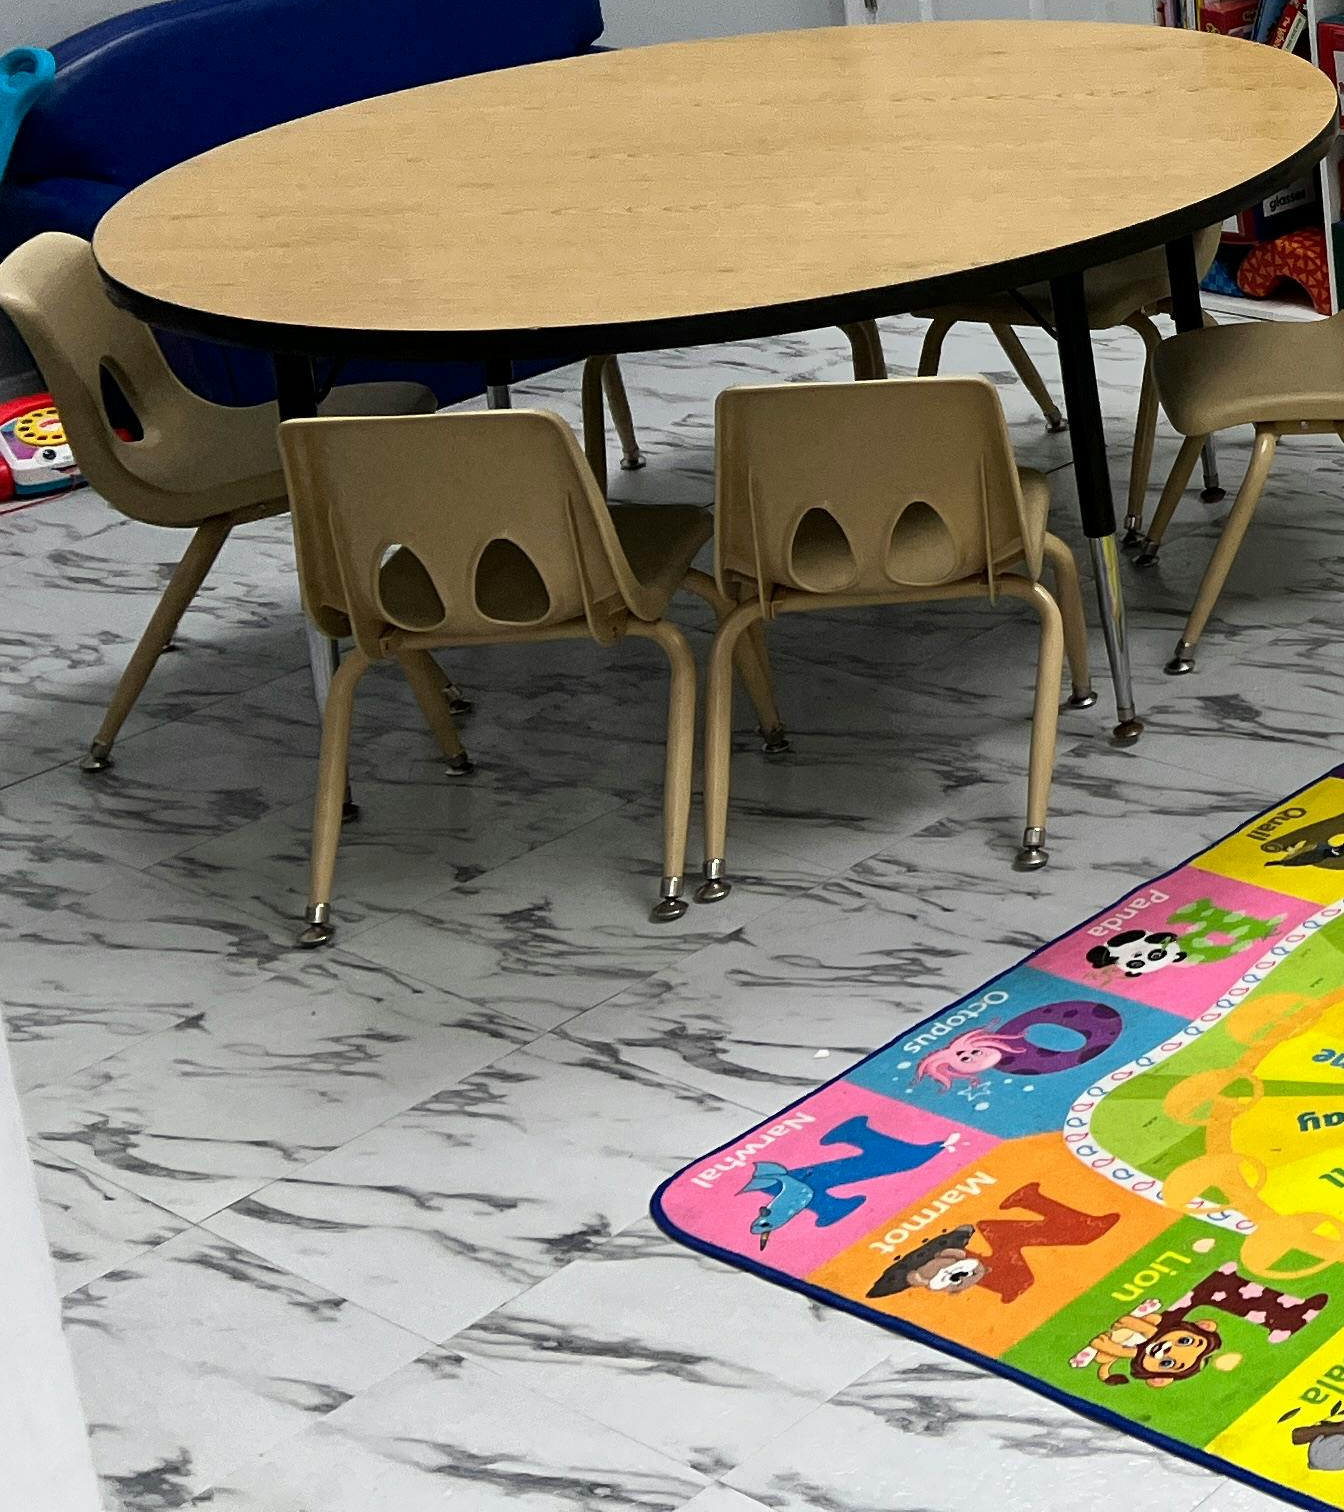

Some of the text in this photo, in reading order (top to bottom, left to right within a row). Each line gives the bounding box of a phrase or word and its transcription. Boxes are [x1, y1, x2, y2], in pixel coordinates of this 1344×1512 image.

[1247, 806, 1308, 842] Quail
[1086, 888, 1170, 937] Panda
[902, 989, 1010, 1055] Octopus
[995, 1000, 1123, 1076] O
[688, 1110, 818, 1192] Narwhal
[868, 1170, 999, 1256] Marmot
[1110, 1250, 1193, 1304] Lion
